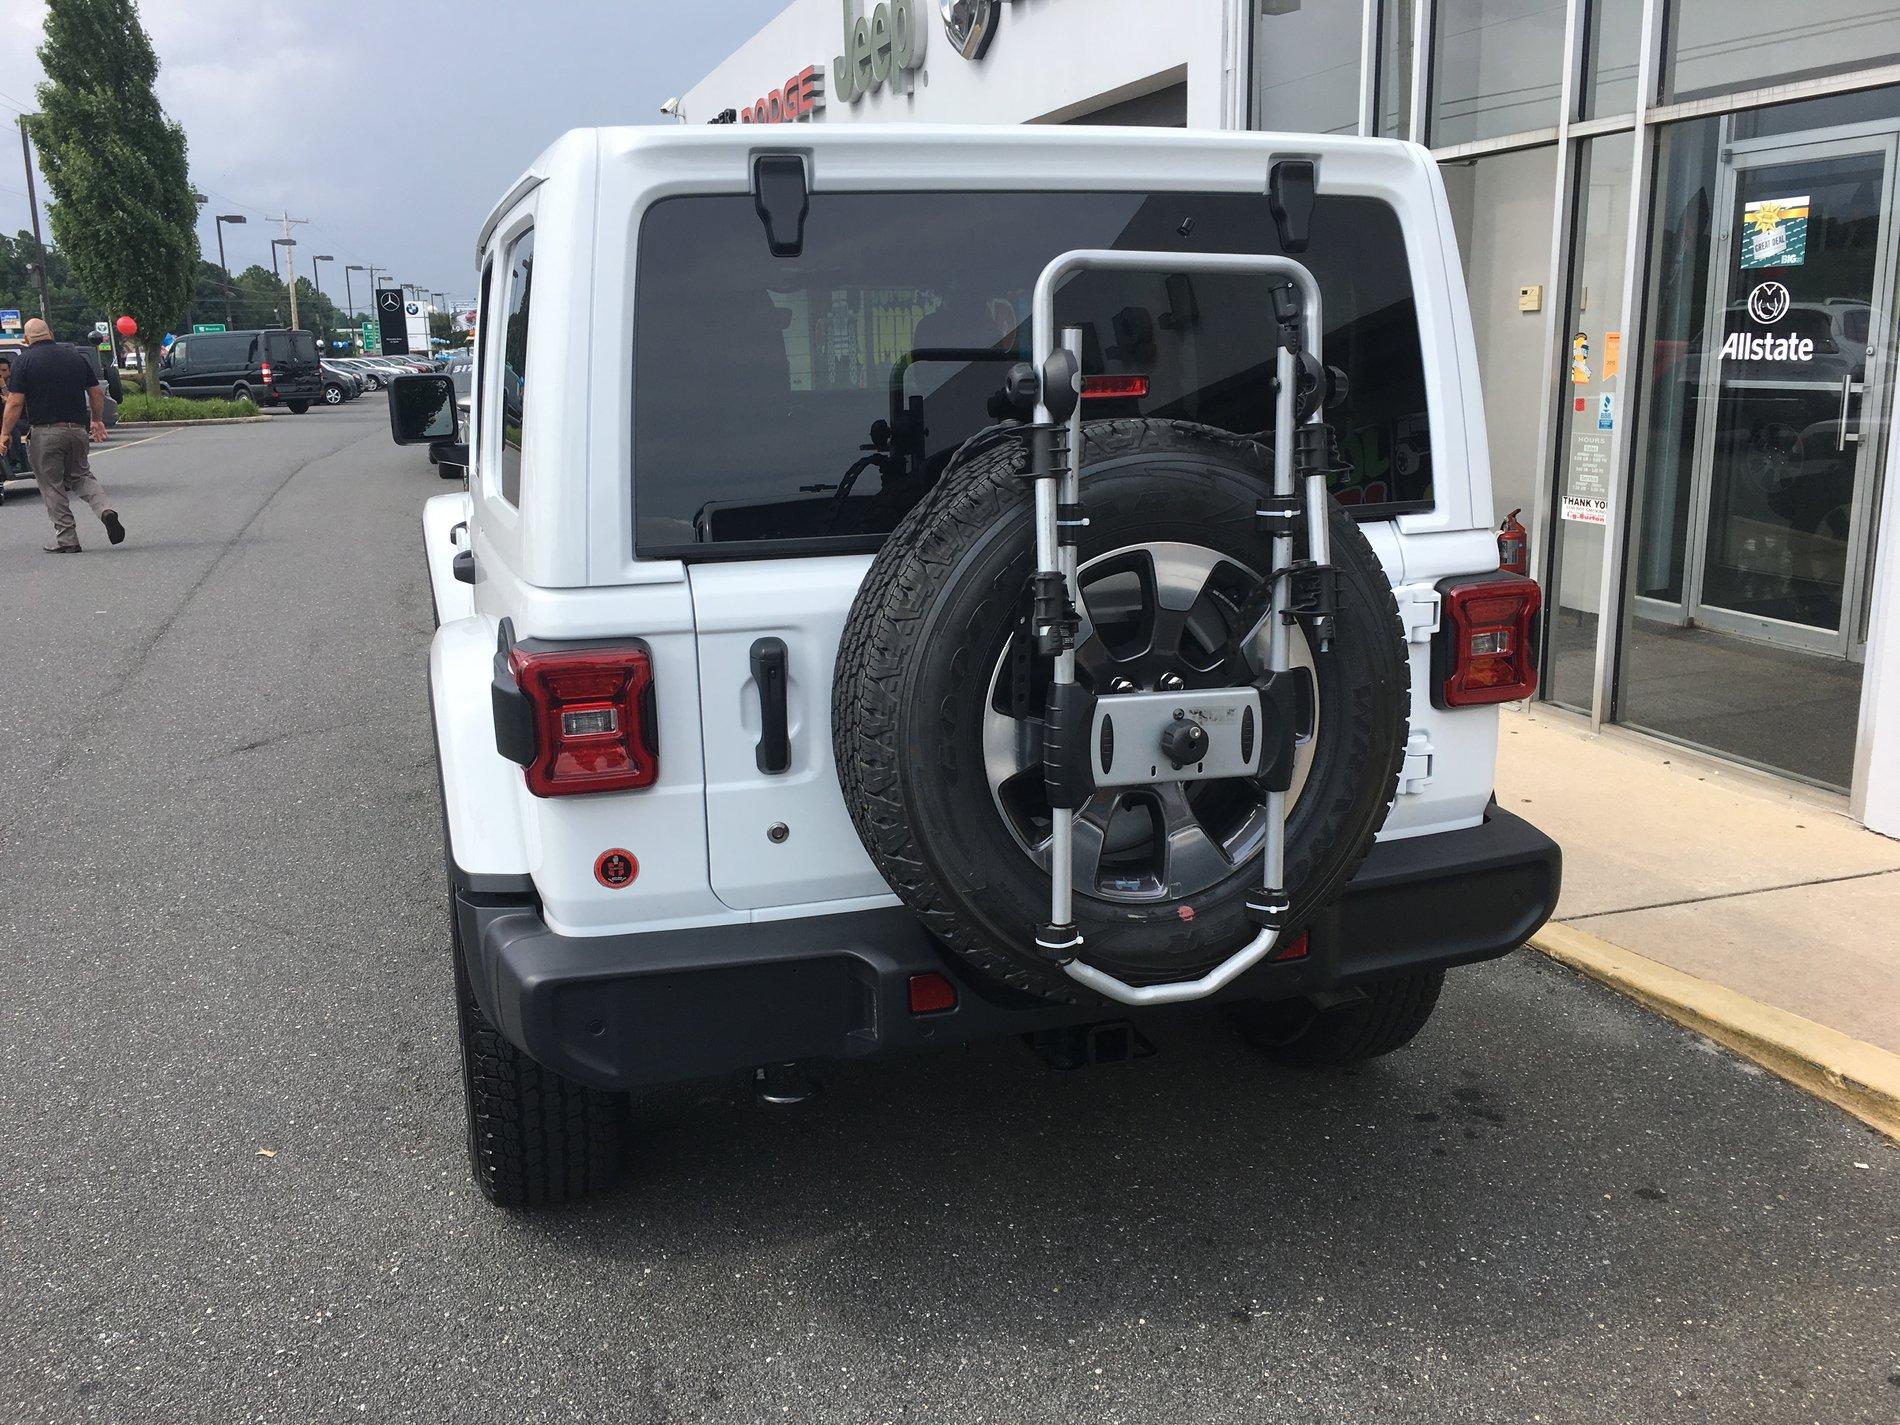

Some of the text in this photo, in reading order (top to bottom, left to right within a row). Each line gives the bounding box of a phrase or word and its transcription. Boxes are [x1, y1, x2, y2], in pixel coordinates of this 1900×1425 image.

[833, 0, 924, 103] Jeep
[741, 64, 820, 123] DODGE
[1754, 235, 1785, 253] GREAT DEAL
[1781, 254, 1797, 264] BIG
[1718, 332, 1814, 361] Allstate
[1578, 436, 1606, 445] HOURS
[1563, 496, 1591, 507] THANK
